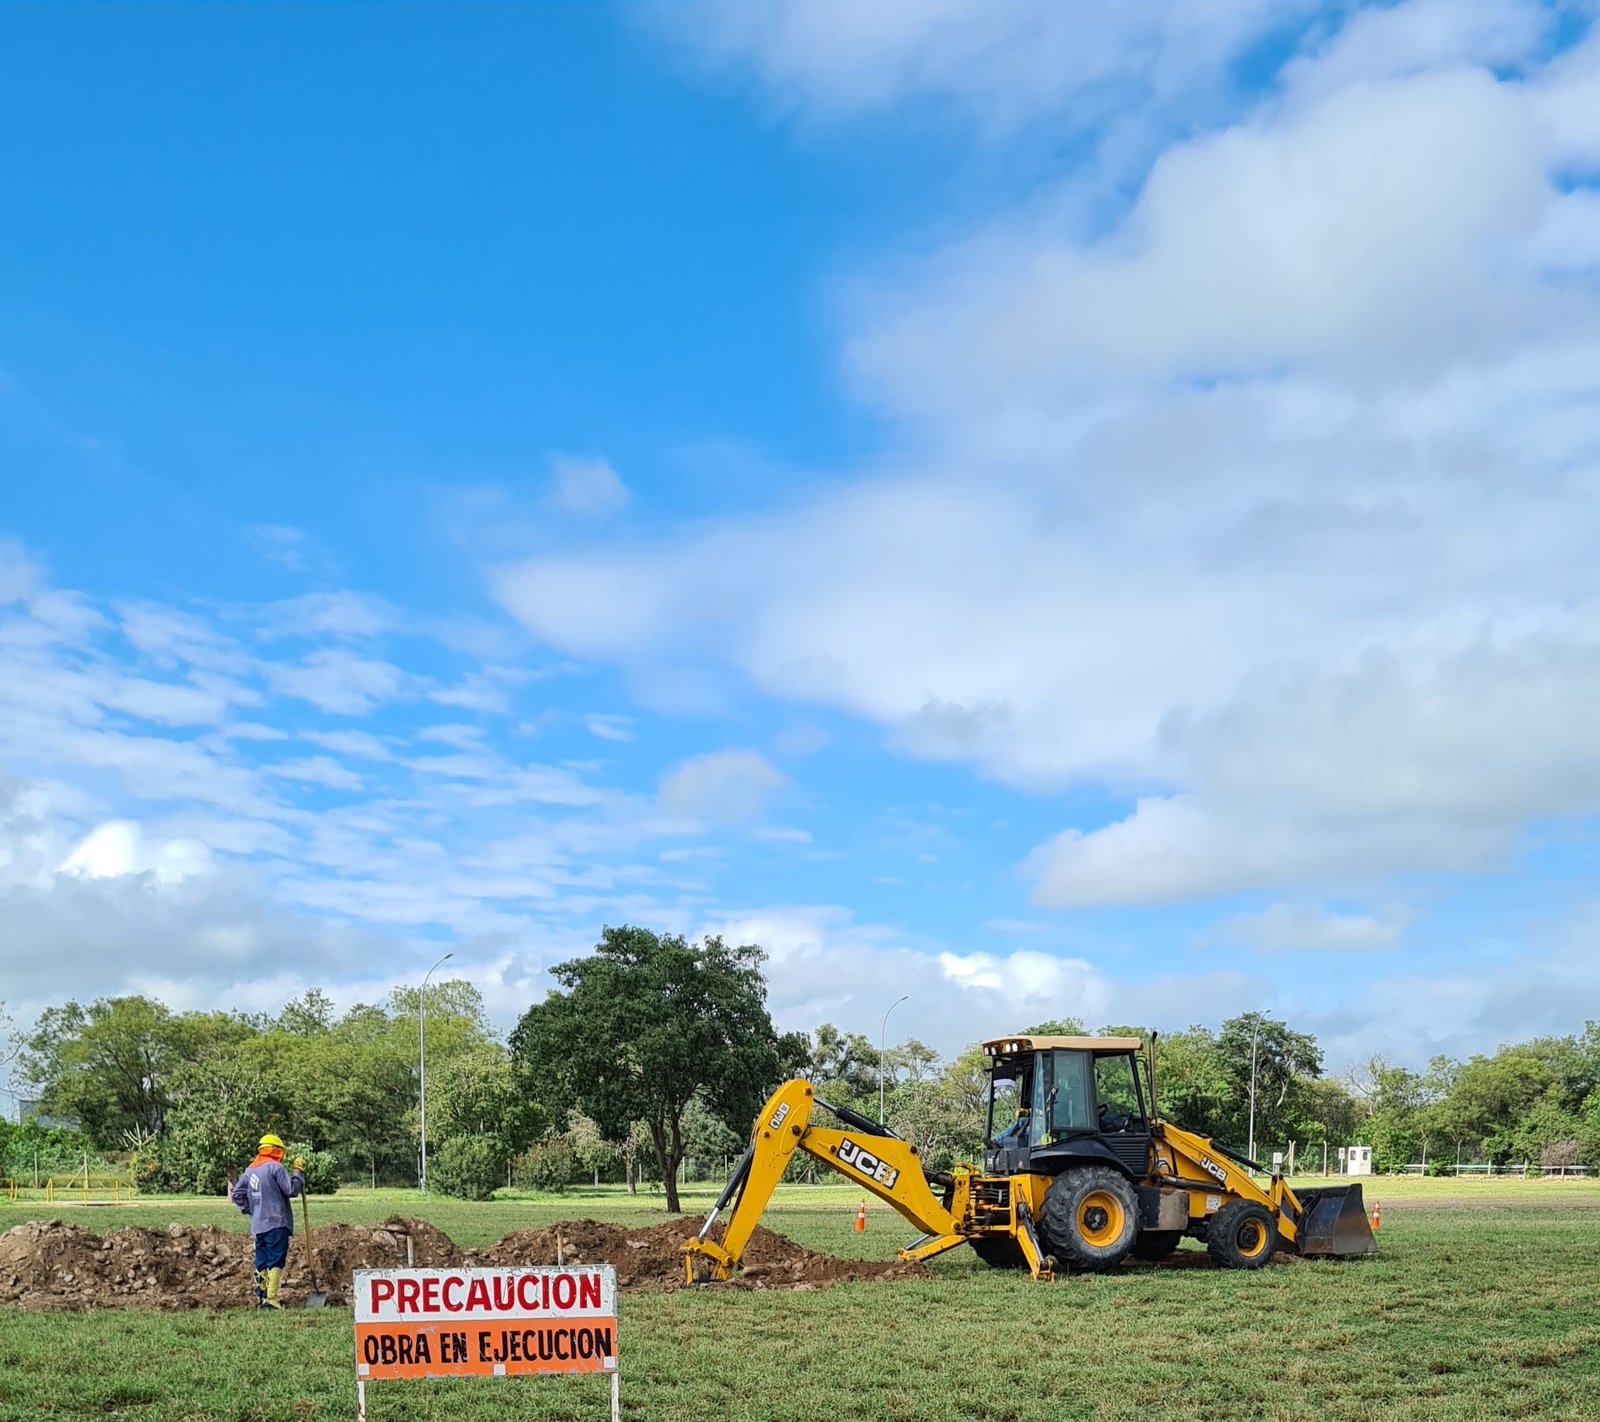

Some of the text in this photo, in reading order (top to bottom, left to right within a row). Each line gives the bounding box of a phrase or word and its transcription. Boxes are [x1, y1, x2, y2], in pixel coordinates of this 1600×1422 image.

[839, 1139, 897, 1187] JCB
[1201, 1156, 1227, 1181] JCB
[371, 1274, 600, 1313] PRECAUCION
[364, 1328, 612, 1365] OBRA EN EJECUCION
